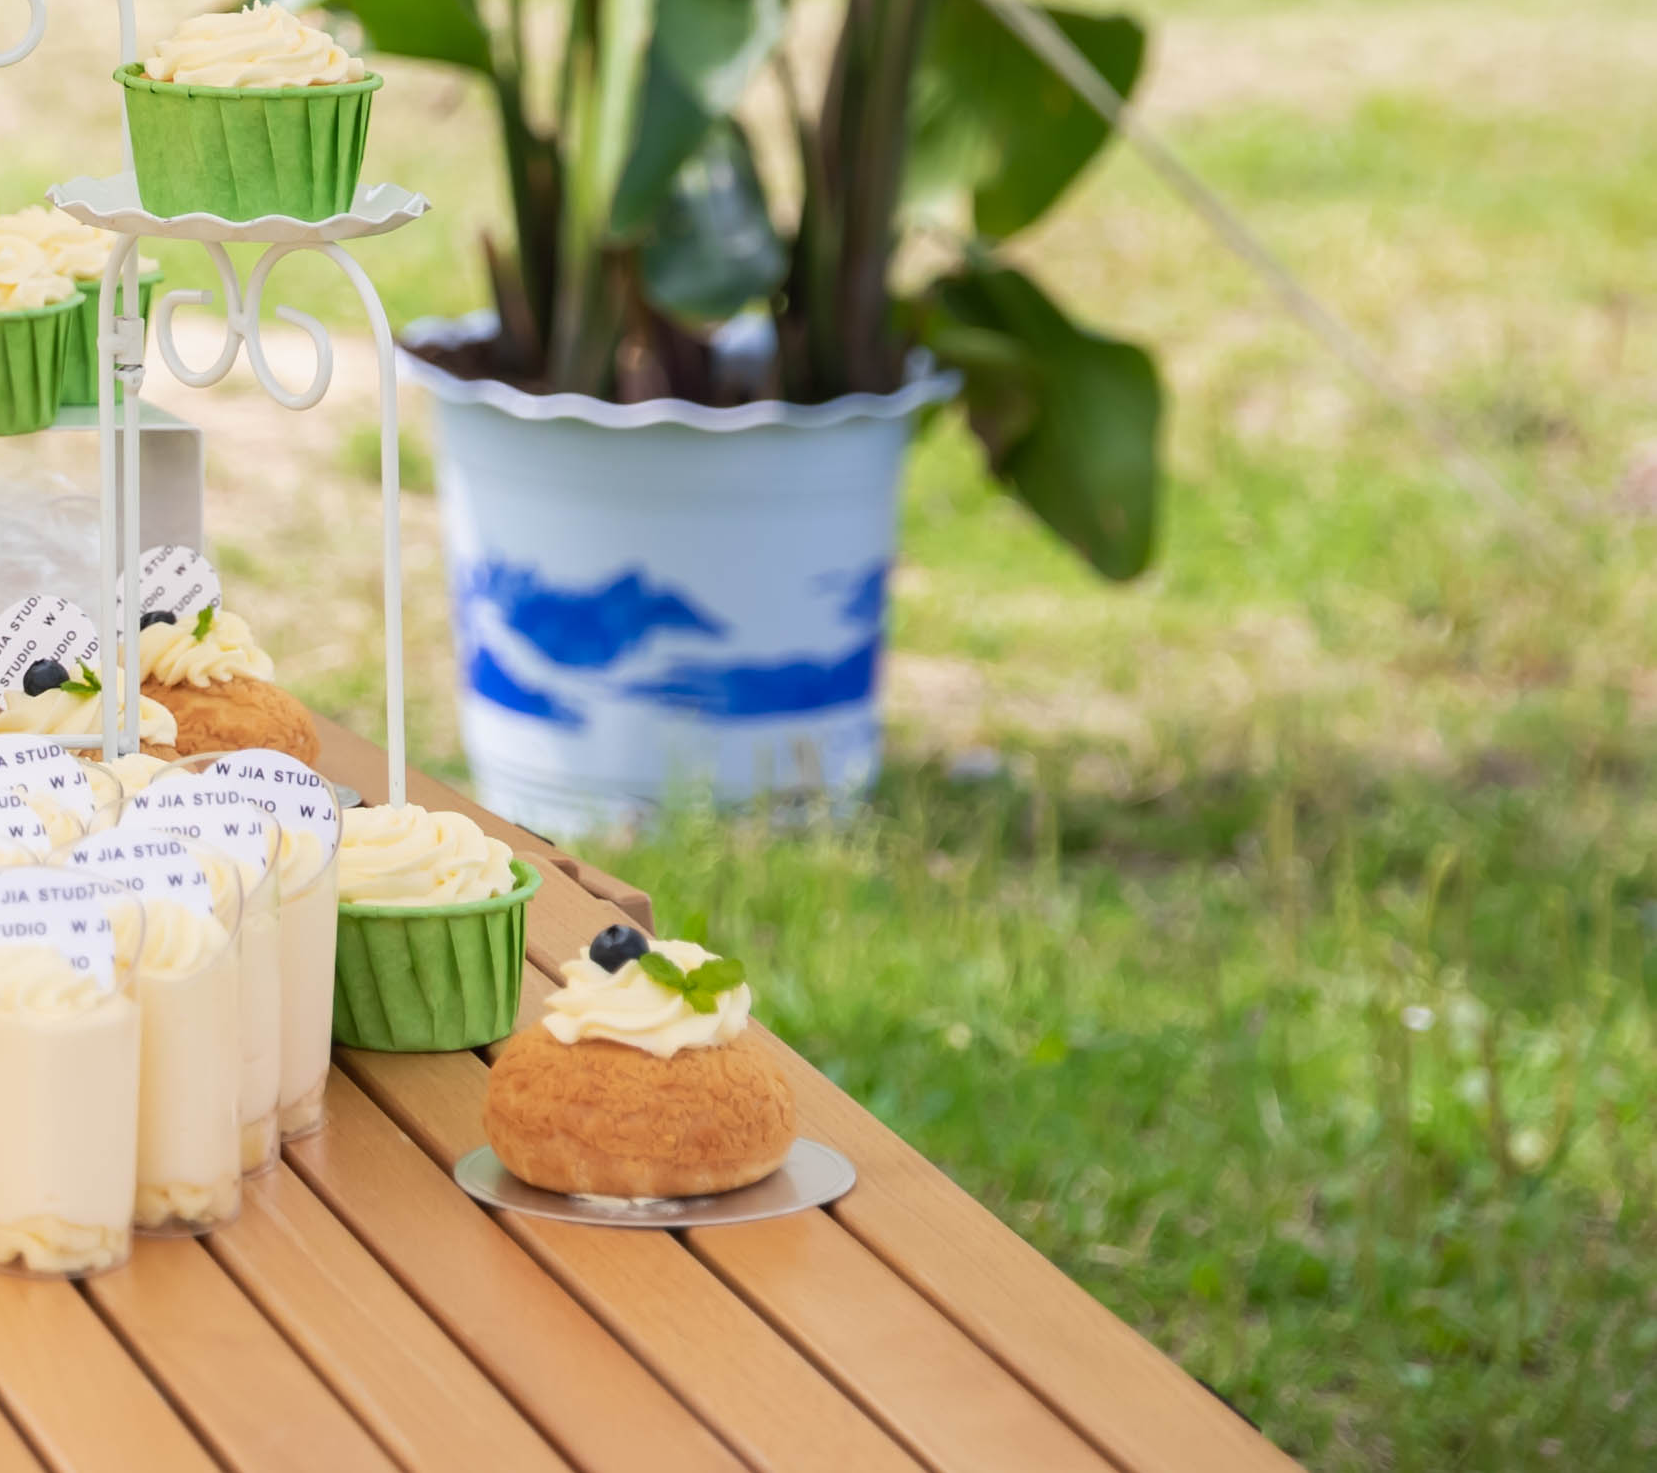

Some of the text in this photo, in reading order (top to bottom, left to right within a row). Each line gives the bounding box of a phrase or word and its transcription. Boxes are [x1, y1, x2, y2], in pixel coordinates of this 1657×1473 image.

[174, 563, 187, 576] W
[10, 595, 42, 632] STUD
[43, 612, 57, 626] W
[0, 639, 38, 687] STUDIO
[15, 744, 66, 765] STUD
[50, 775, 65, 790] W
[216, 762, 325, 788] W JIA STUD
[134, 790, 245, 810] W JIA STUD
[300, 804, 316, 819] W
[9, 824, 25, 838] W
[223, 823, 240, 837] W
[73, 841, 187, 864] W JIA STUD
[167, 873, 183, 887] W
[1, 890, 30, 904] JIA
[38, 884, 93, 902] STUD
[71, 920, 87, 934] W
